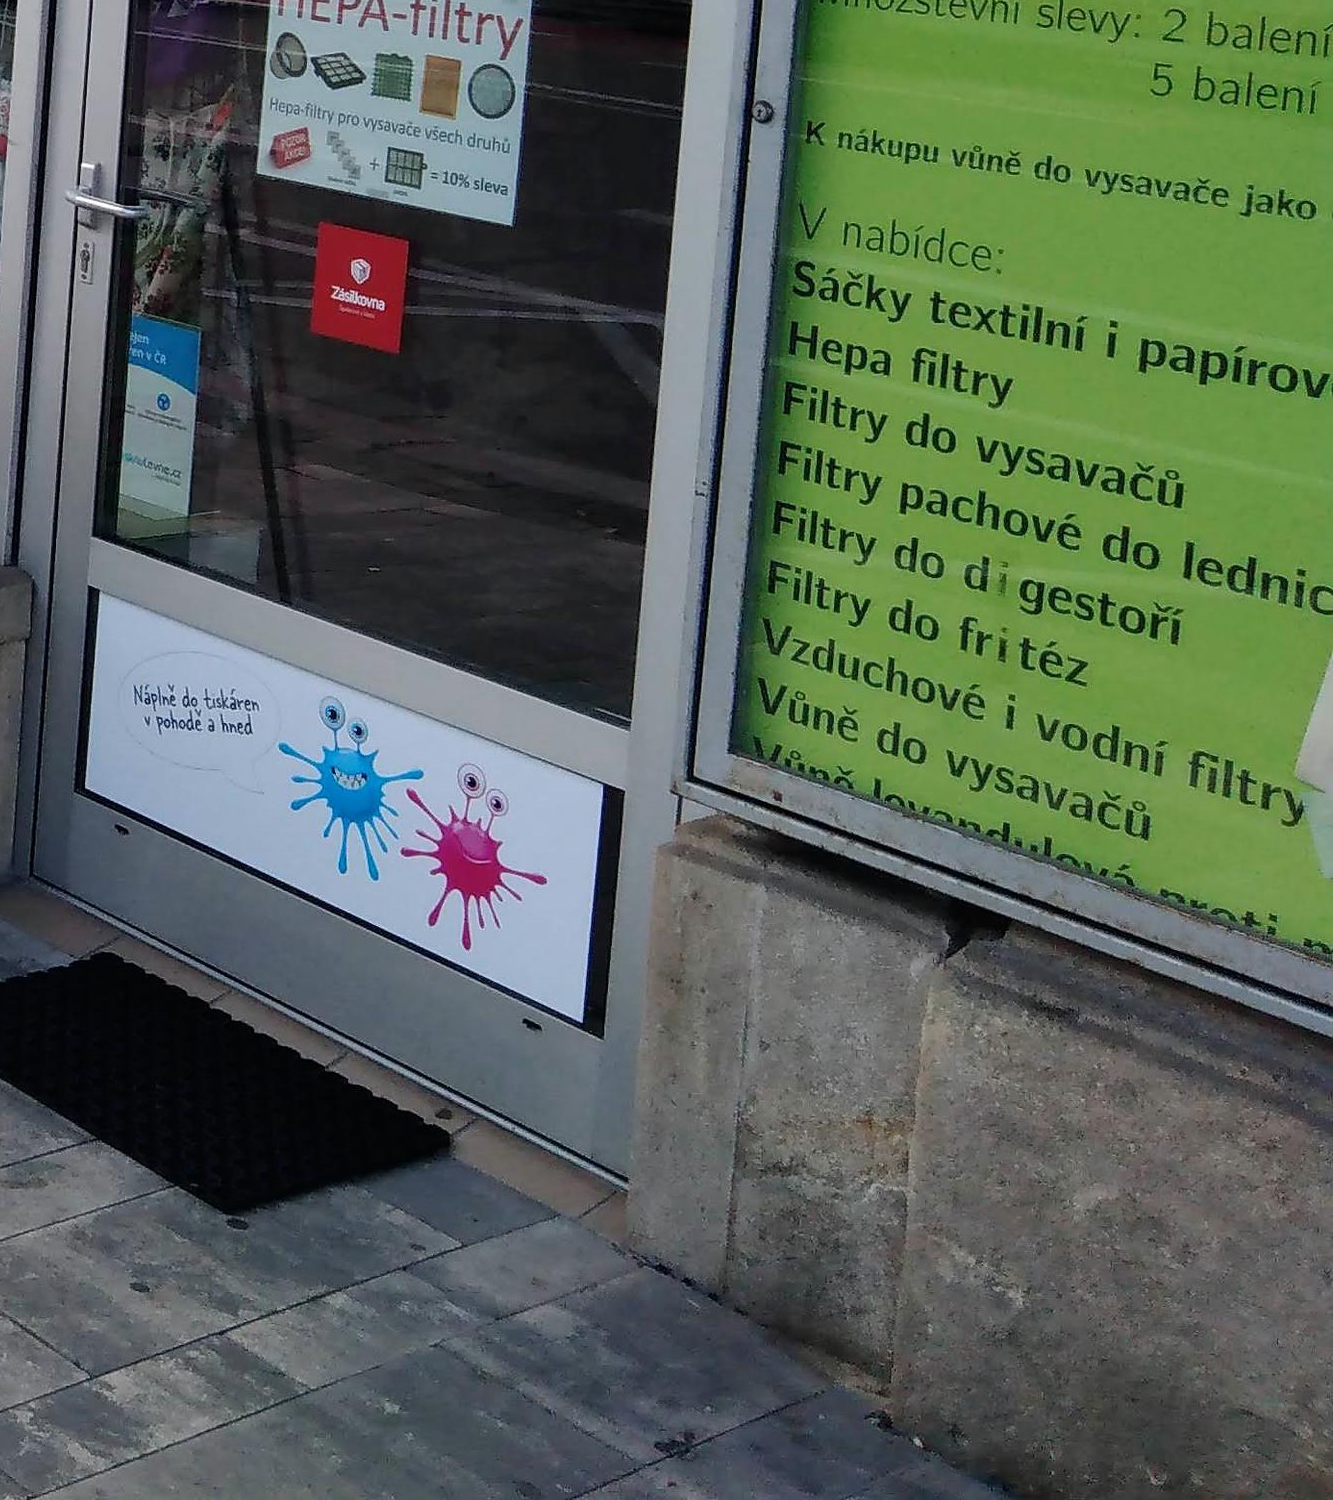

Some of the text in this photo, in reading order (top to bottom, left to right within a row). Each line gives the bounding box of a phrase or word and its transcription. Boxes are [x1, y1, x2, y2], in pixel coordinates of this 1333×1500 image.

[1162, 8, 1187, 43] 2
[1206, 11, 1333, 59] balení
[269, 97, 511, 155] Hepa-filtry pro vysavače všech druhů
[1149, 62, 1321, 116] 5 balení
[442, 171, 470, 189] 10%
[472, 175, 509, 196] sleva
[804, 121, 1317, 222] K nákupu vůně do vysavače jako
[797, 202, 1005, 274] V nabídce:
[330, 285, 386, 312] Zásilkovna
[792, 260, 1333, 401] Sáčky textilní i papírov
[787, 320, 1015, 409] Hepa filtry
[781, 380, 1187, 510] Filtry do vysavačů
[772, 500, 876, 566] Filtry
[893, 536, 945, 580] do
[777, 441, 1333, 618] Filtry pachové do lednic
[766, 559, 1090, 689] Filtry do fritéz
[133, 684, 260, 712] Náplně do tiskáren
[144, 709, 253, 735] v pohodě a hned
[761, 617, 1306, 828] Vzduchové i vodní filtry
[756, 677, 859, 744] Vůně
[877, 721, 928, 765] do
[946, 748, 1152, 842] vysavačů
